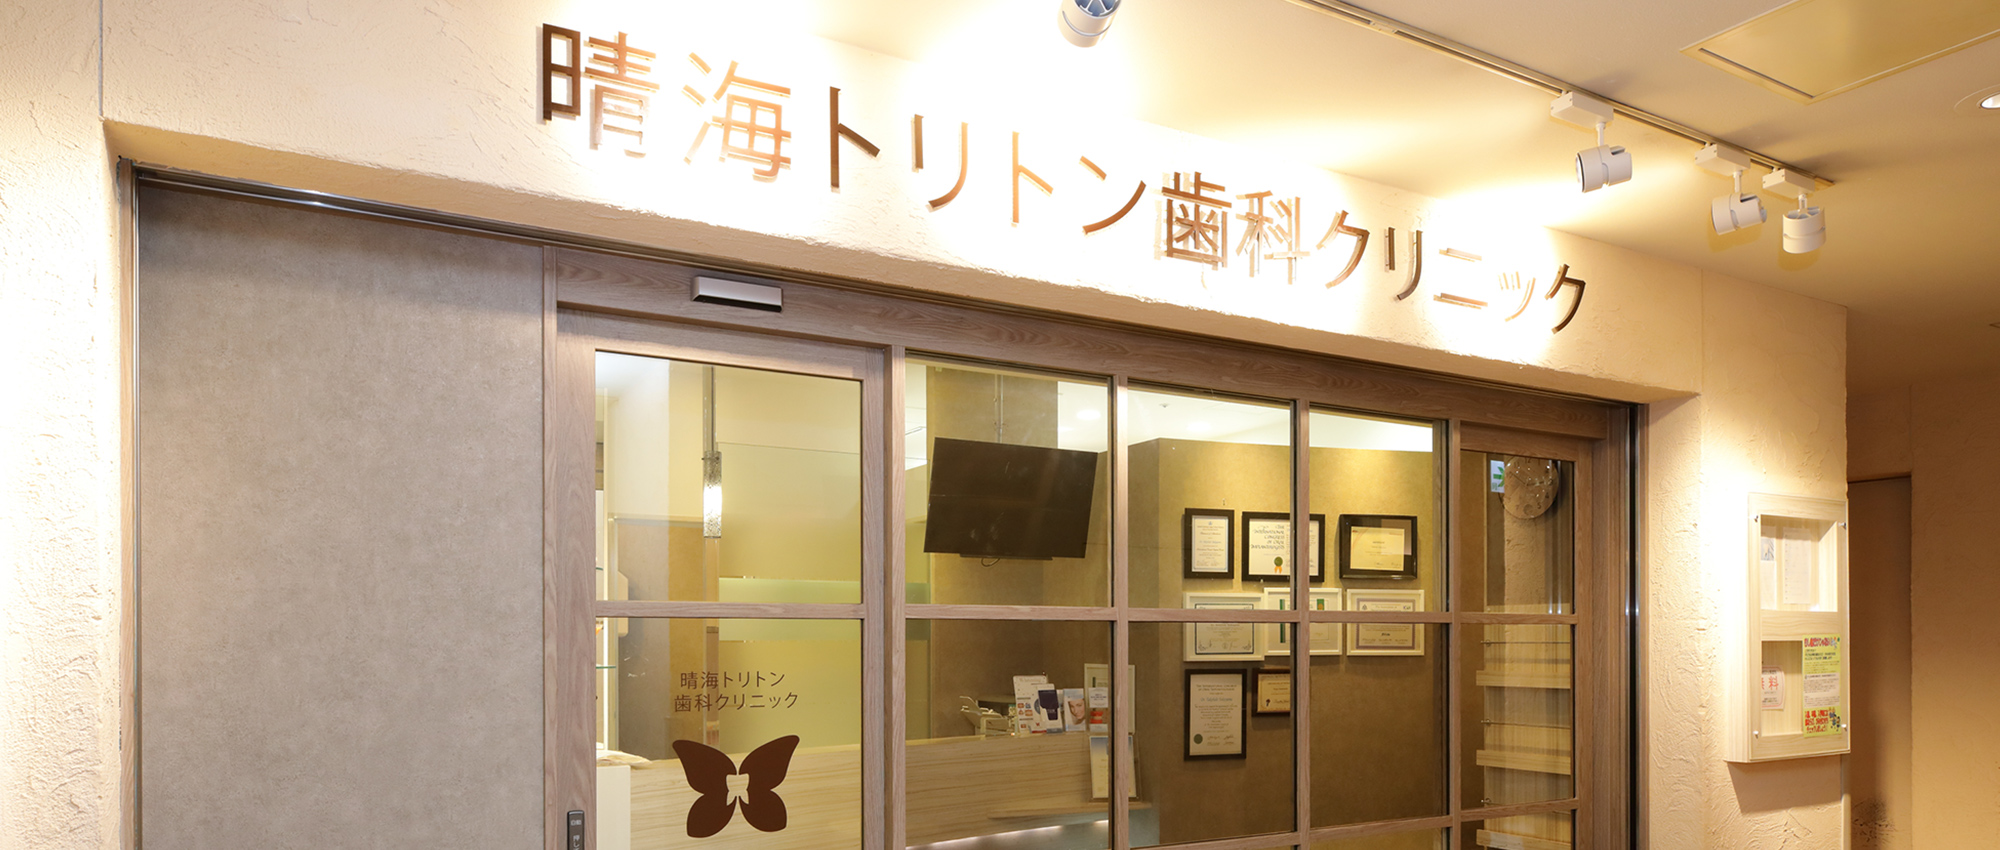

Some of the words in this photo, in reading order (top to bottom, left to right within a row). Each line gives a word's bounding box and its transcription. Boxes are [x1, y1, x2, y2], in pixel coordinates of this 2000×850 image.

[542, 23, 1586, 334] 晴海トリトン歯科クリニック
[680, 671, 785, 690] 晴海トリトン
[674, 692, 798, 712] 歯科クリニック
